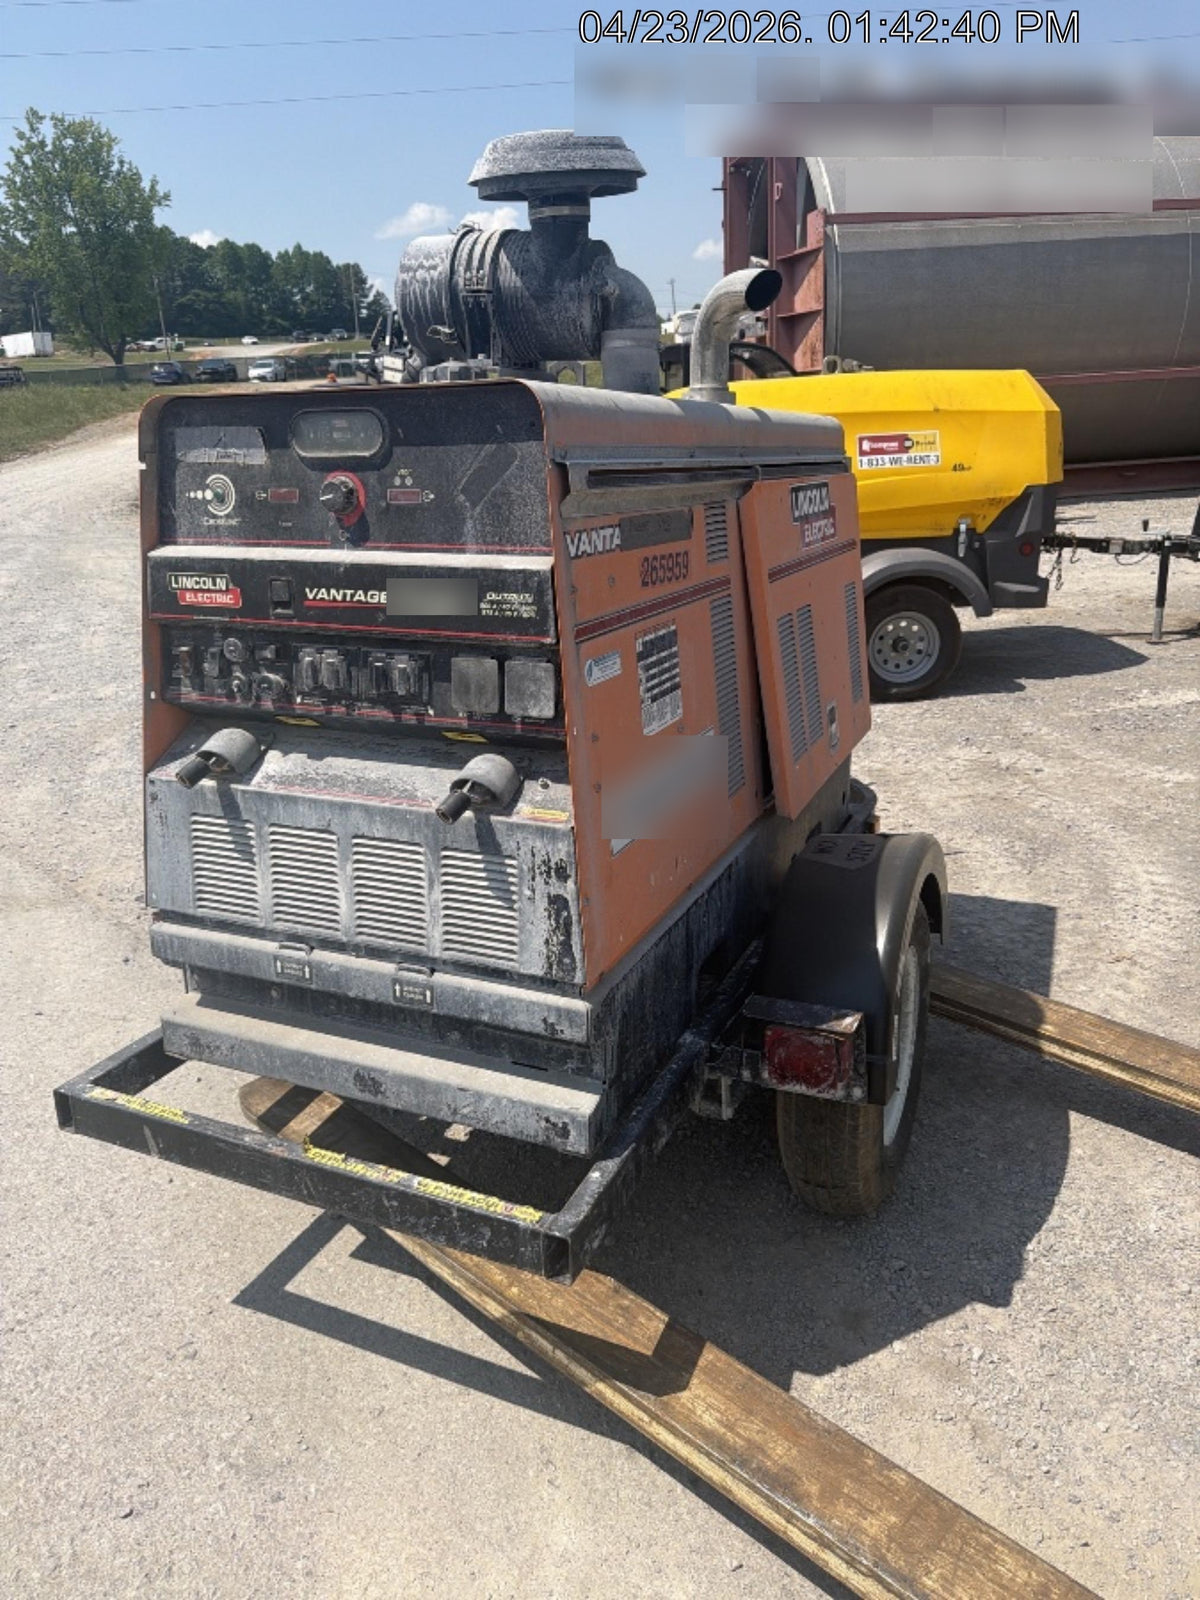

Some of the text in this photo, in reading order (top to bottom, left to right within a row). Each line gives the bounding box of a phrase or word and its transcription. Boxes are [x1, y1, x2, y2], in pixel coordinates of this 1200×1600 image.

[793, 486, 830, 518] LINCOLN
[804, 517, 835, 543] ELECTRIC
[640, 550, 690, 588] 265959
[171, 575, 227, 591] LINCOLN
[185, 592, 235, 604] ELECTRIC
